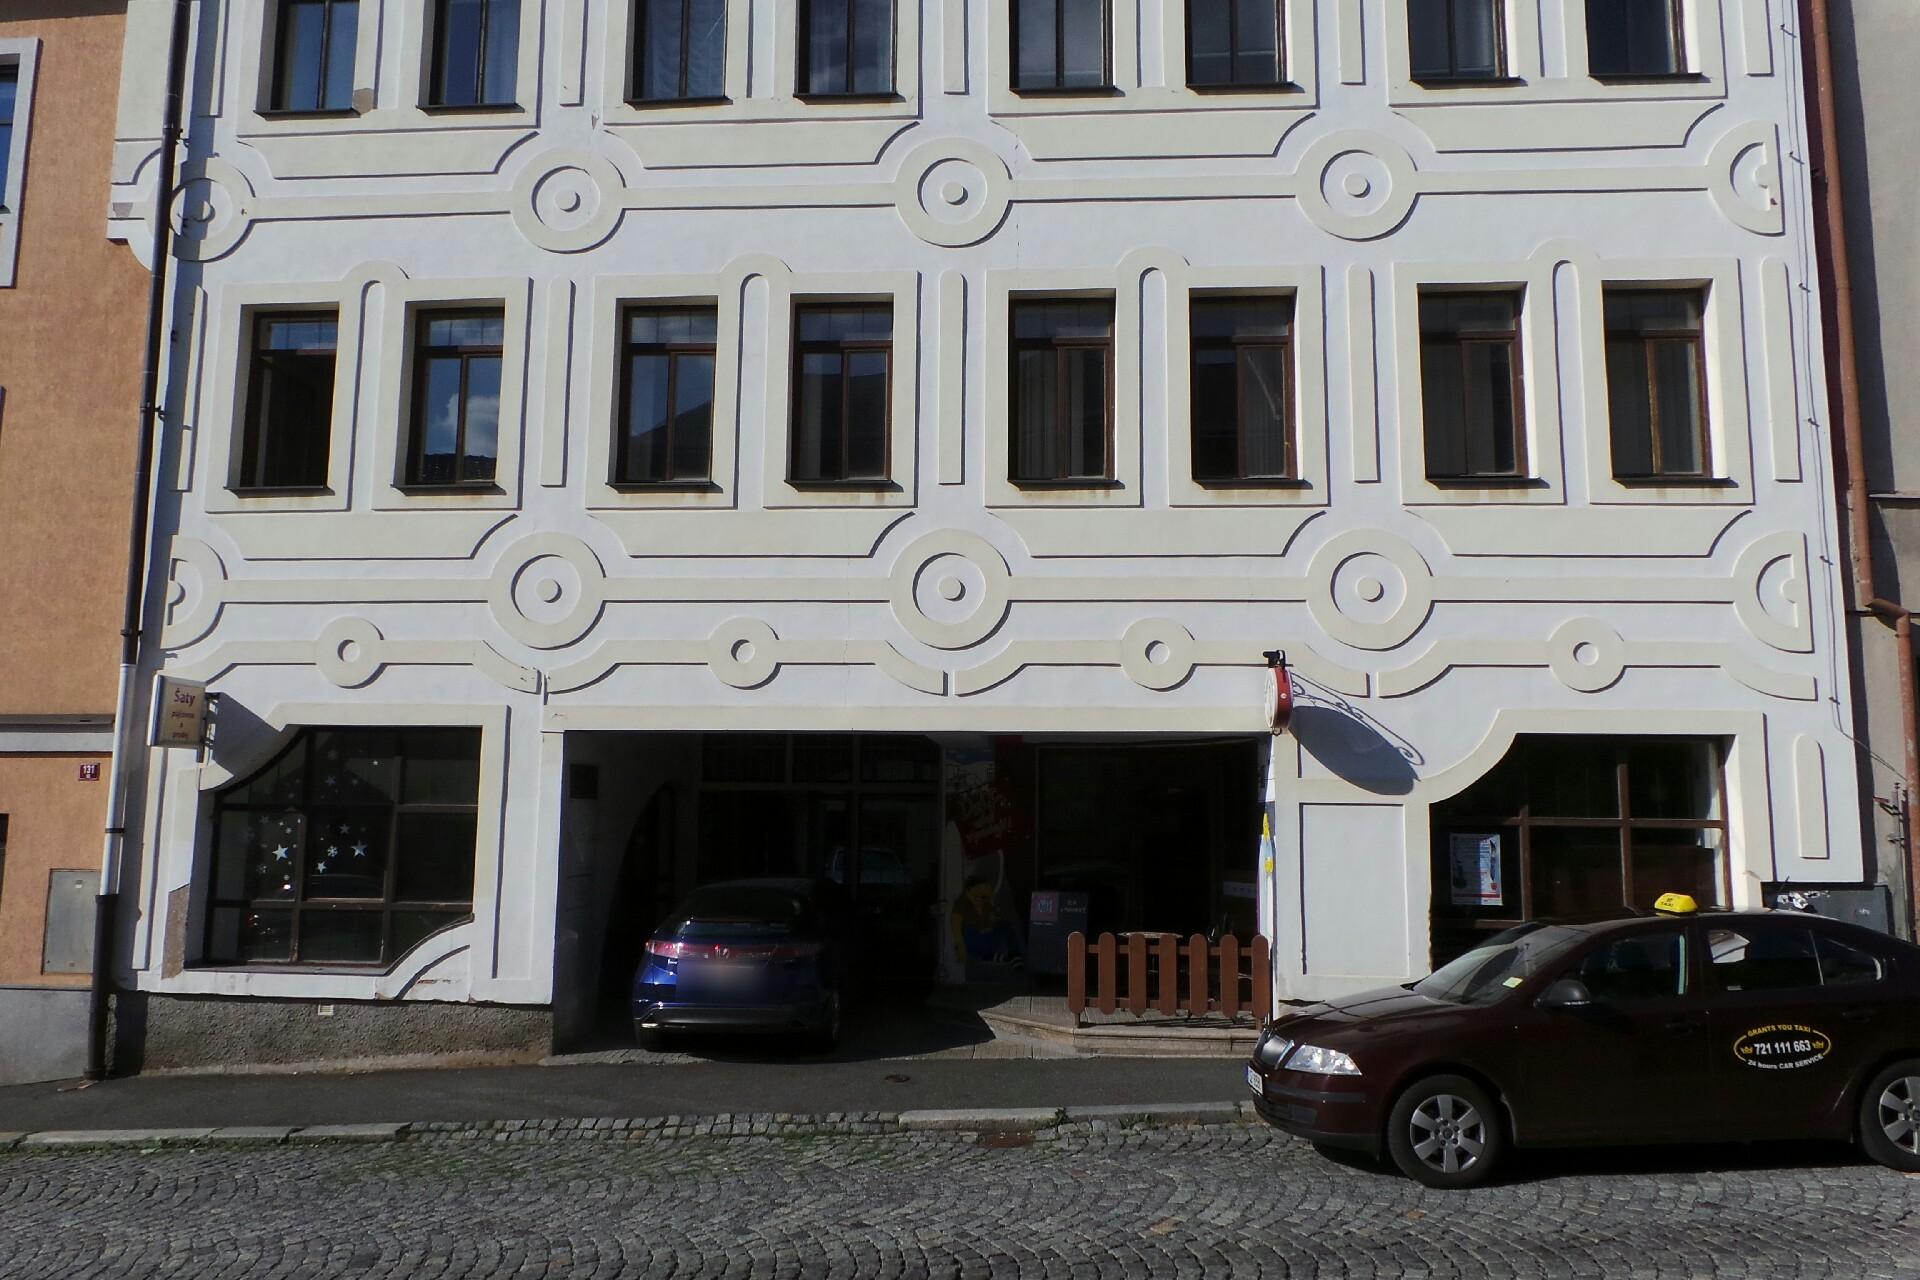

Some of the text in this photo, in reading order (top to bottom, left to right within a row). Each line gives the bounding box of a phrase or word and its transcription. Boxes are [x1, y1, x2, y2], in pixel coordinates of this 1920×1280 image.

[174, 688, 195, 706] Šaty
[1747, 1025, 1776, 1036] GRANTS
[1793, 1024, 1811, 1033] TAXI
[1753, 1039, 1811, 1055] 721 111 663
[1795, 1053, 1824, 1067] SERVICE
